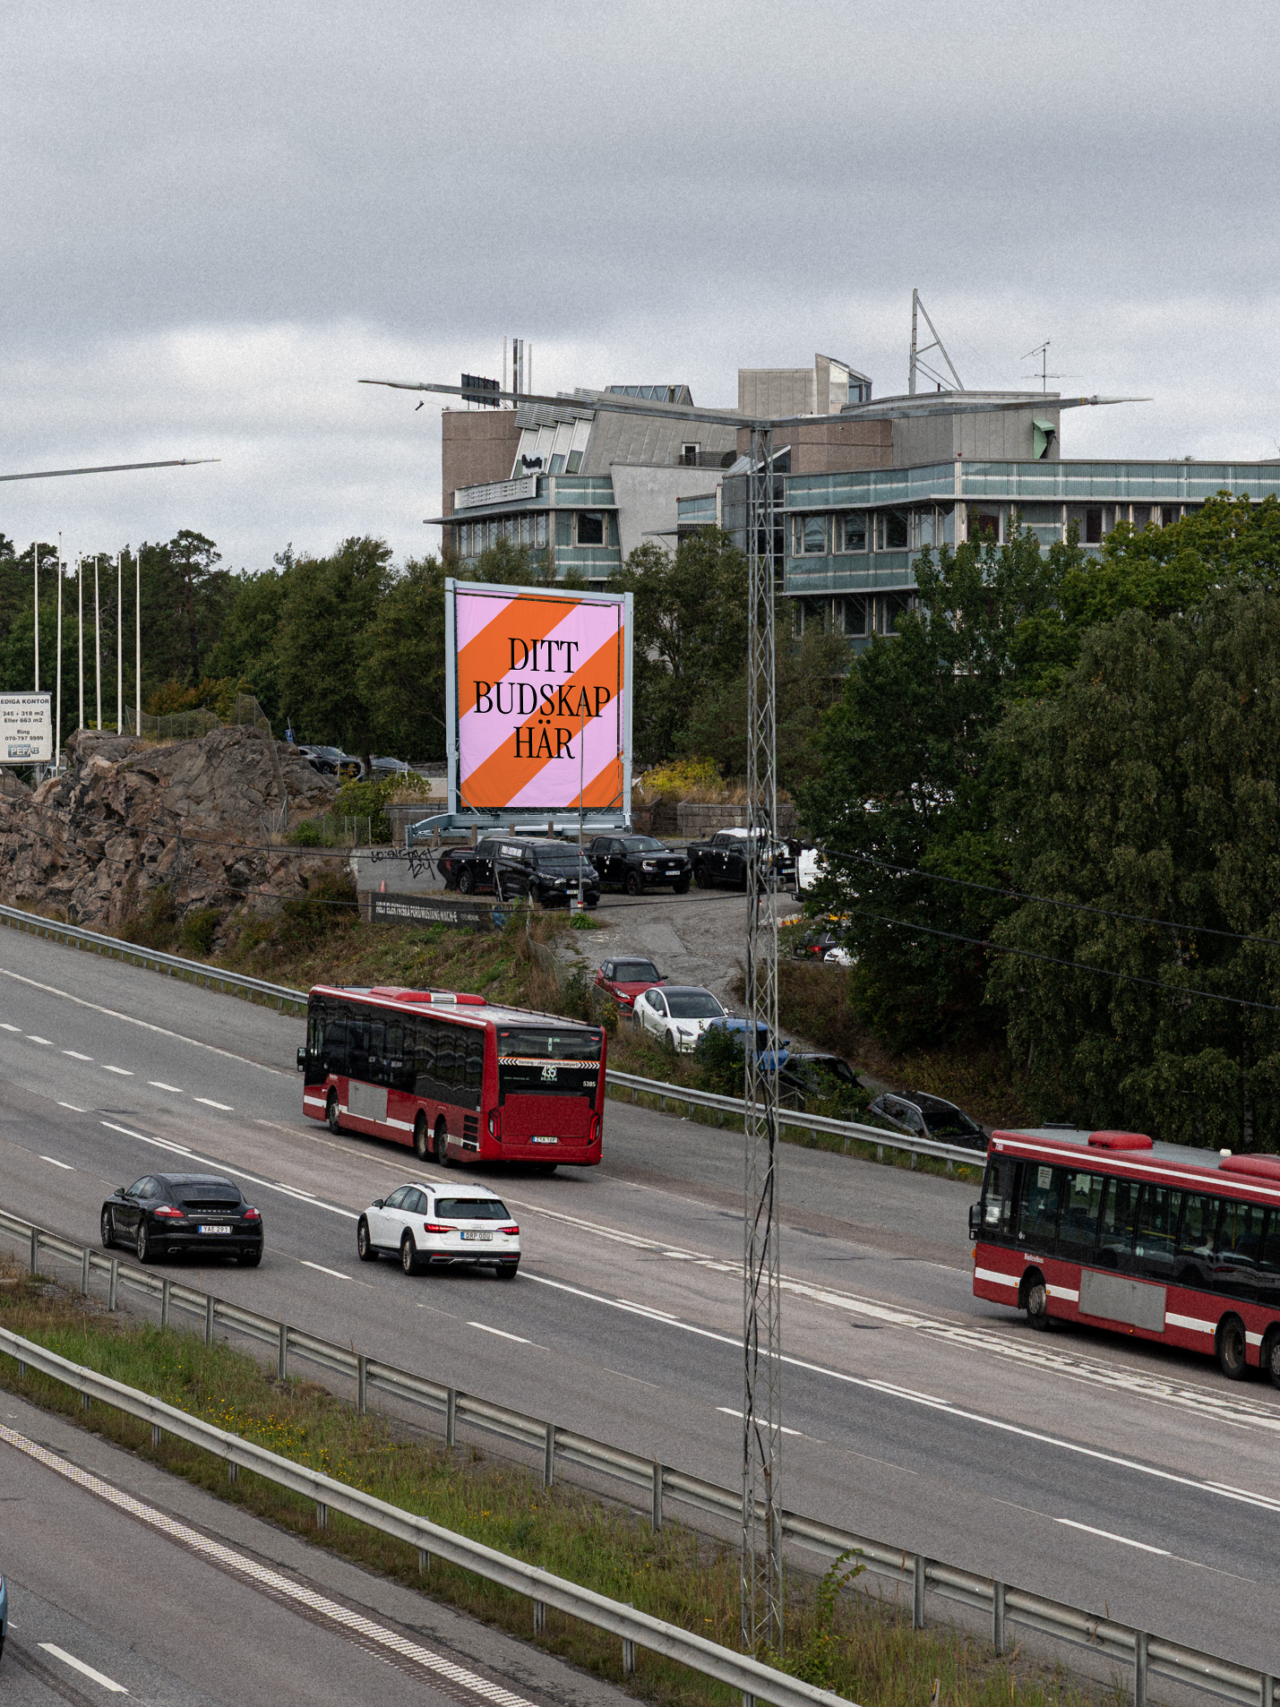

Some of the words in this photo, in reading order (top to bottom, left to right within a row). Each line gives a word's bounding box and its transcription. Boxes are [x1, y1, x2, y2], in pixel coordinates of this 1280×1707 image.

[508, 637, 579, 673] DITT
[473, 680, 611, 718] BUDSKAP
[513, 719, 576, 760] HÄR
